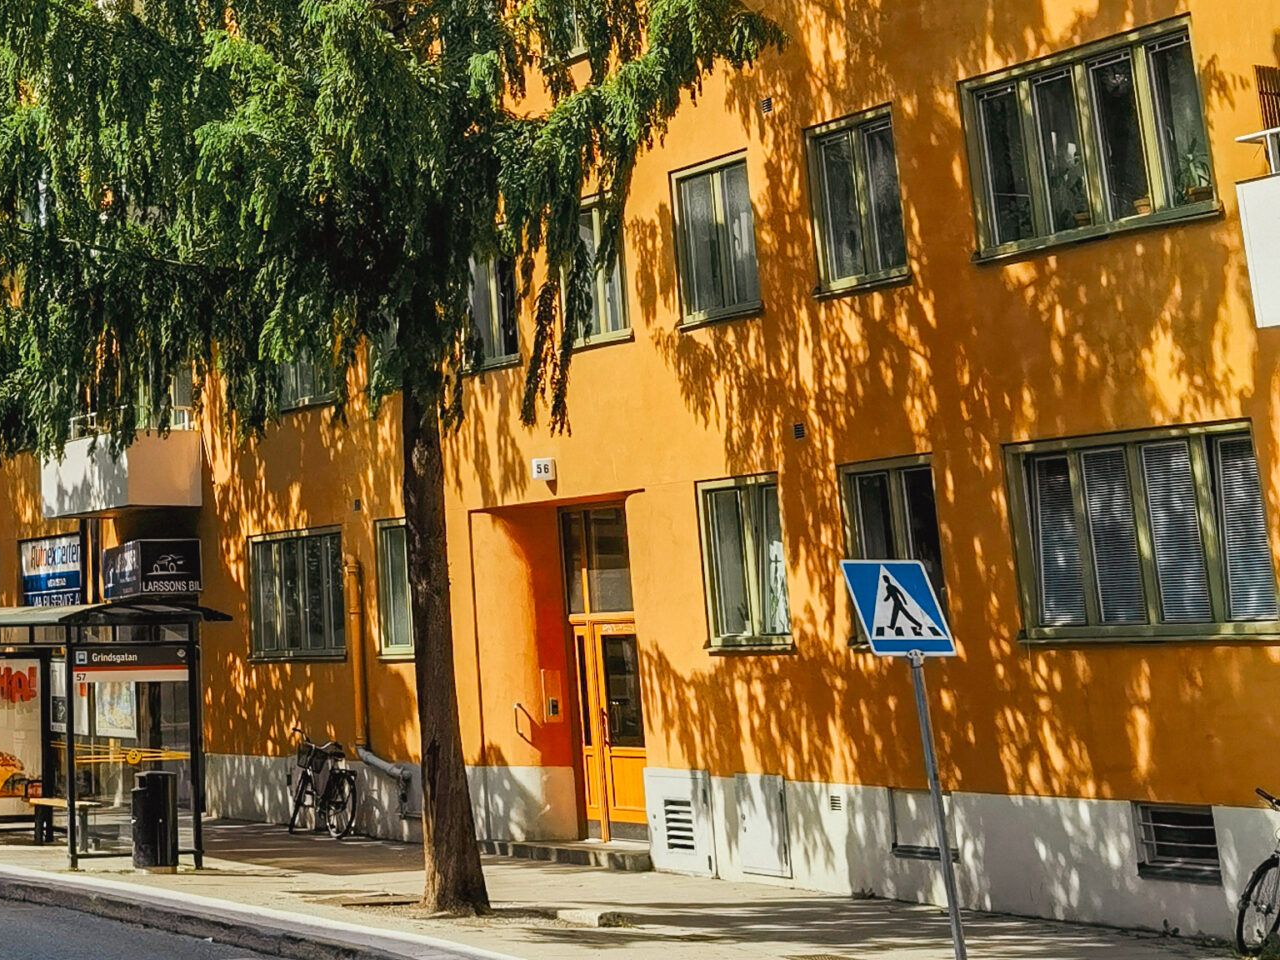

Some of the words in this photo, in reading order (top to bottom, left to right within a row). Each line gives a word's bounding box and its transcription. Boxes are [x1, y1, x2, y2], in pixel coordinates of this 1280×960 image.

[536, 463, 550, 474] 56
[142, 581, 187, 591] LARSSONS
[91, 652, 138, 663] Grindsgatan
[76, 673, 86, 681] 57
